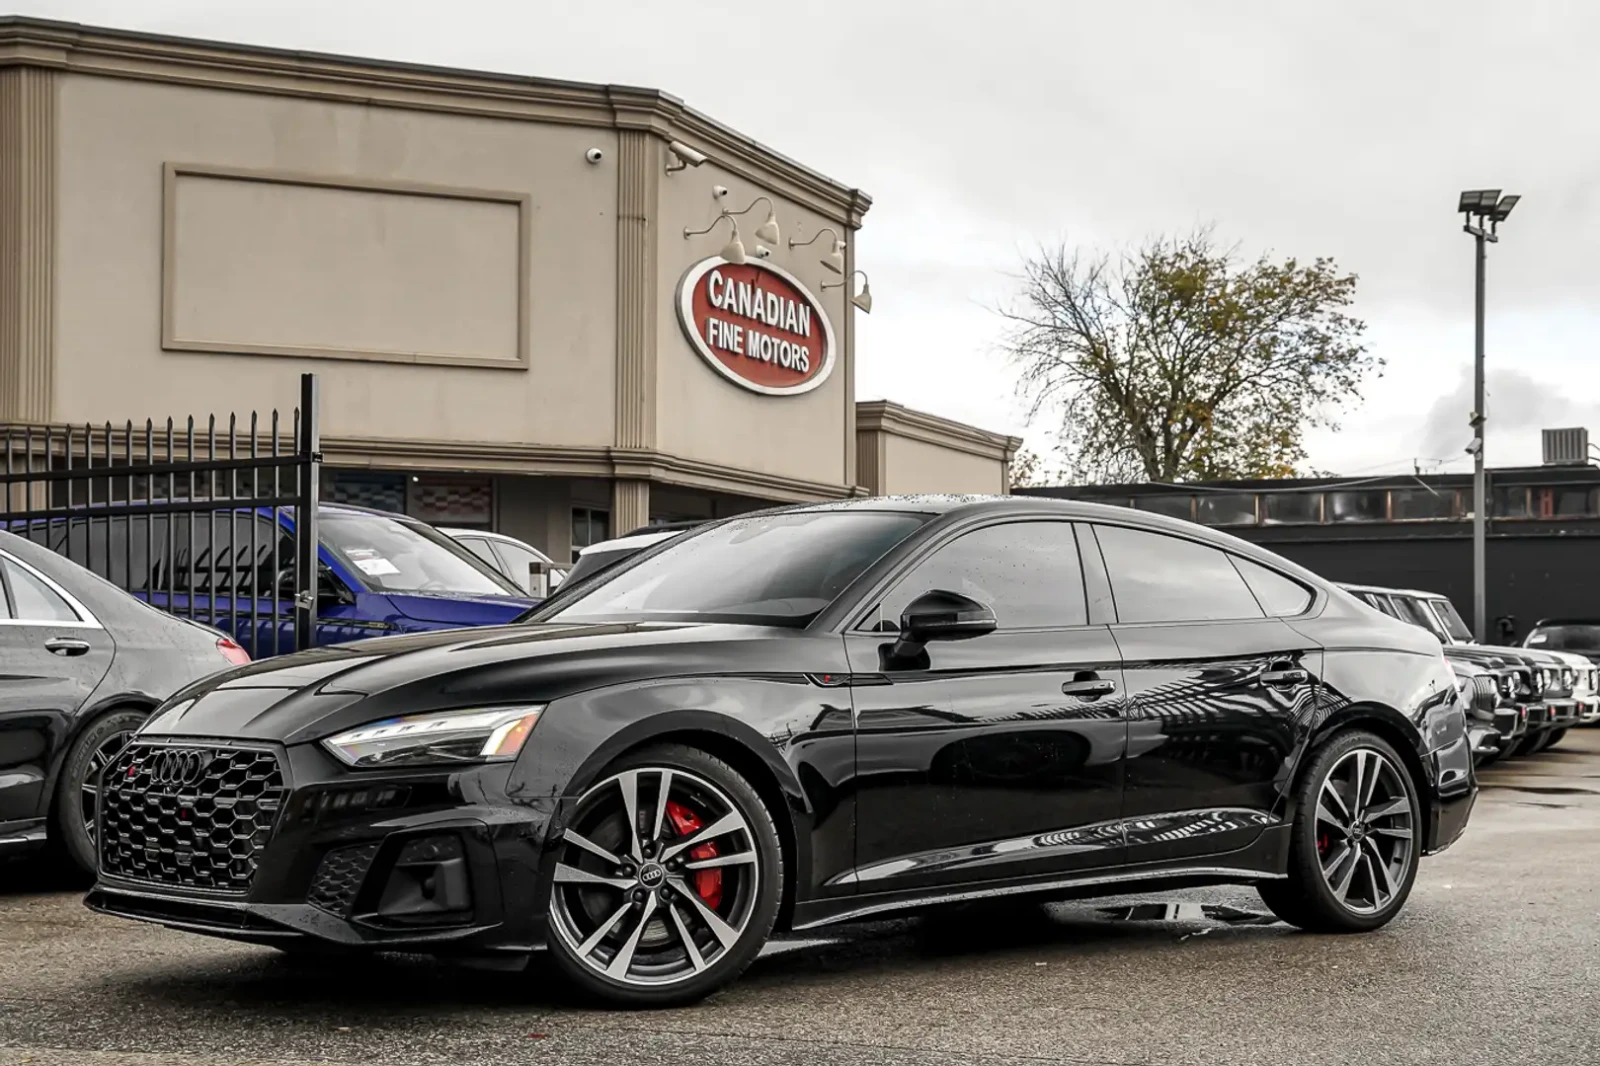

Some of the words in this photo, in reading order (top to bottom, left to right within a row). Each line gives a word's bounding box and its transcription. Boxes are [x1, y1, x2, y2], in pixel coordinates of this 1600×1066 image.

[708, 269, 811, 337] CANADIAN
[707, 317, 744, 354] FINE
[748, 329, 810, 373] MOTORS
